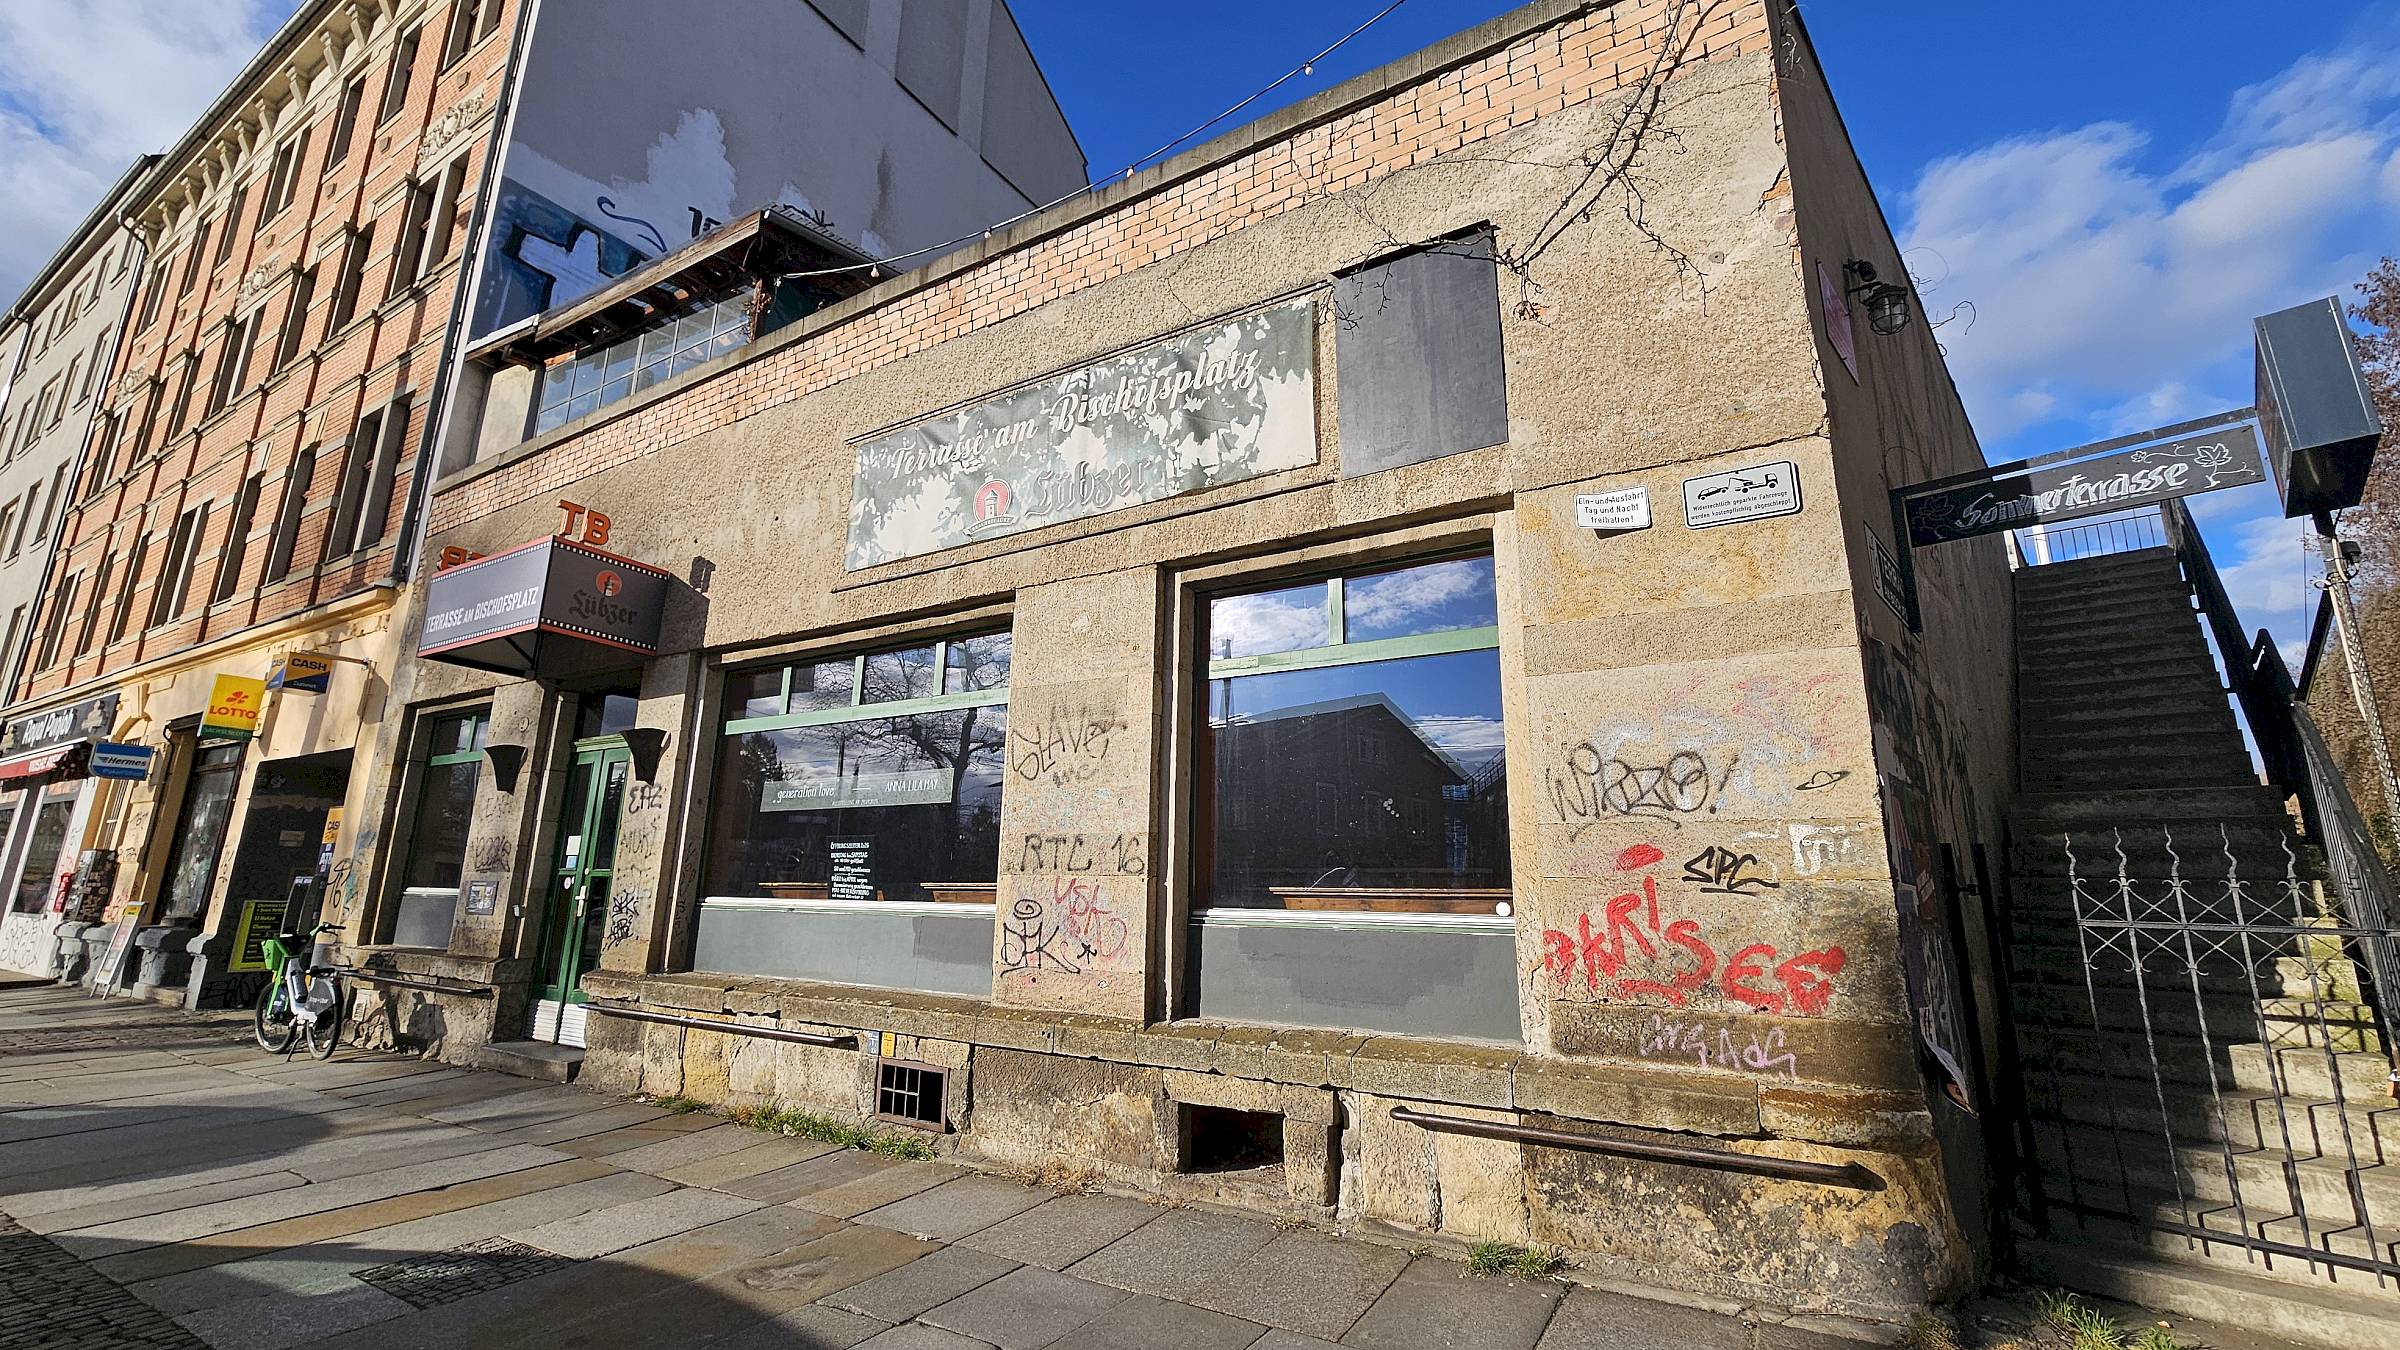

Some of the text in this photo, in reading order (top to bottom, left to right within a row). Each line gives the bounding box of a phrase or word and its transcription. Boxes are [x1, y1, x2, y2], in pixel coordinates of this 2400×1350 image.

[892, 350, 1262, 480] Terrasse am Bischofsplatz
[1759, 490, 1788, 500] Fahrzeuge
[1584, 503, 1639, 515] Tag und Nacht
[556, 499, 611, 546] TB
[425, 587, 540, 634] TERRASSE AM BISCHOFSPLATZ
[568, 589, 638, 625] Lübzer
[291, 658, 328, 672] CASH
[209, 706, 257, 720] LOTTO
[106, 756, 147, 767] Hermes
